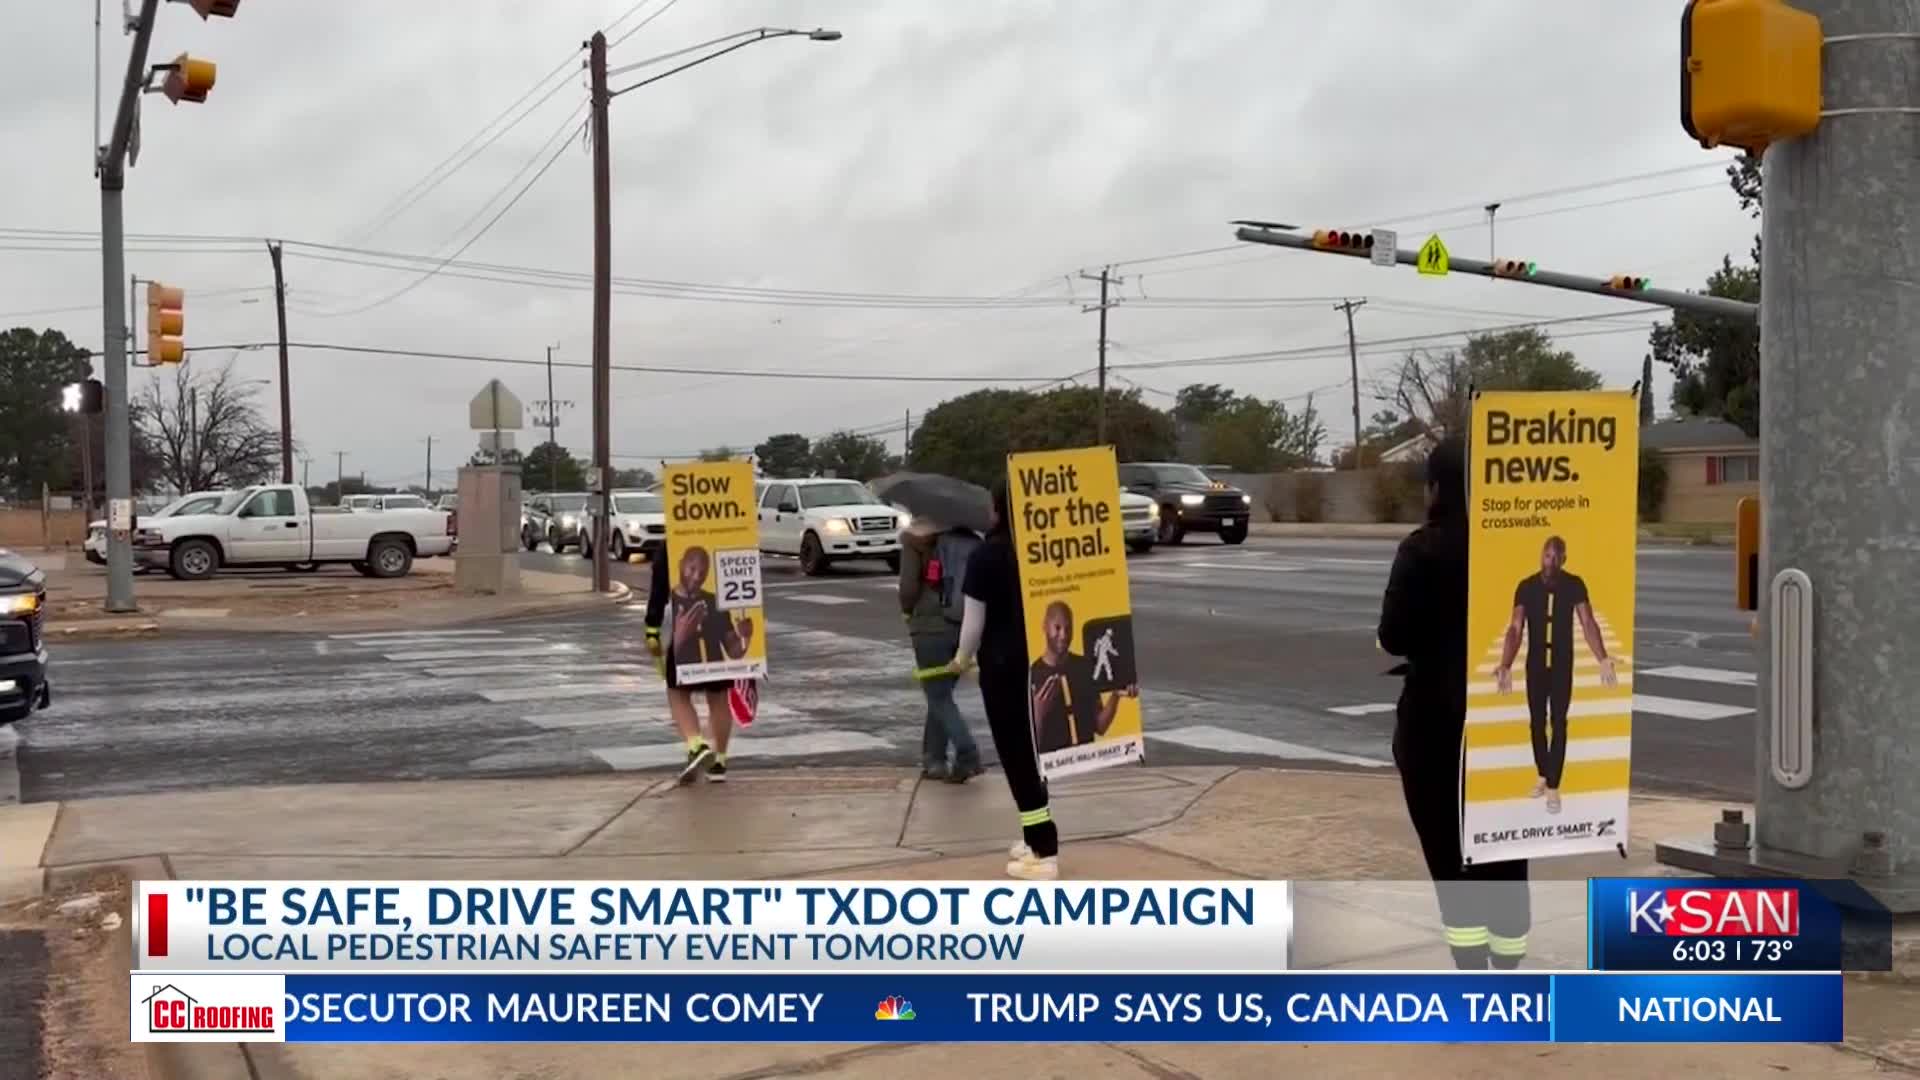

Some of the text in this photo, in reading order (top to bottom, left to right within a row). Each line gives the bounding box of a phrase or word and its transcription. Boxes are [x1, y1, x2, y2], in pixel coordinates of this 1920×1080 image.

[1486, 409, 1617, 451] Braking
[1018, 464, 1078, 497] Wait
[1484, 453, 1580, 485] news.
[671, 473, 731, 496] Slow
[672, 498, 747, 522] down.
[1022, 497, 1110, 532] for the
[1481, 494, 1591, 512] Stop for people in
[1481, 515, 1552, 529] crosswalks.
[1026, 528, 1111, 568] signal.
[720, 556, 757, 567] SPEED
[723, 566, 753, 577] LIMIT
[723, 580, 757, 601] 25
[1473, 832, 1489, 844] BE
[1522, 825, 1554, 839] DRIVE
